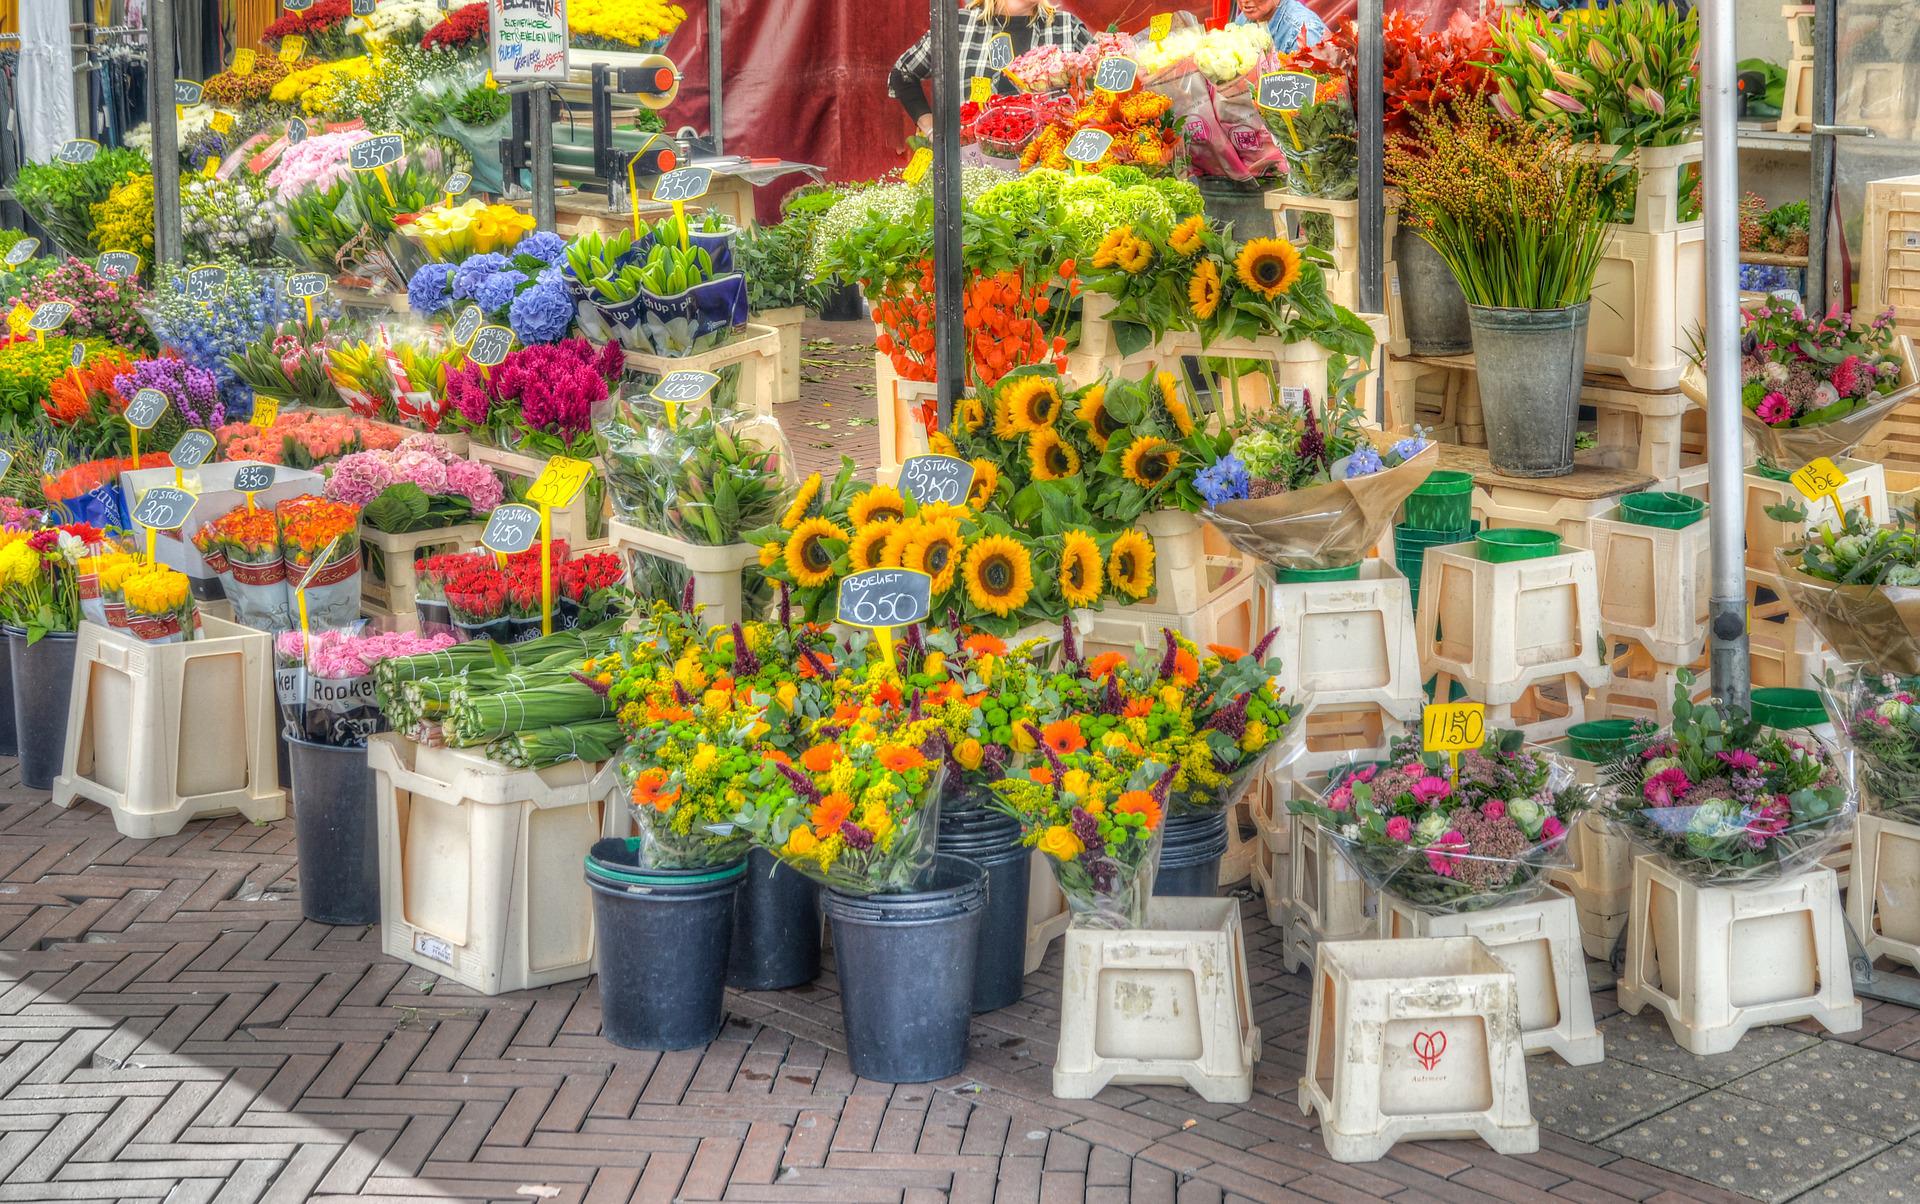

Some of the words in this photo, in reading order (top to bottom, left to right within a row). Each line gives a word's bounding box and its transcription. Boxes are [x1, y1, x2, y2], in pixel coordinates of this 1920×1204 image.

[380, 136, 401, 145] BOS
[655, 302, 670, 314] Up
[907, 459, 924, 480] 5
[146, 489, 158, 500] 10
